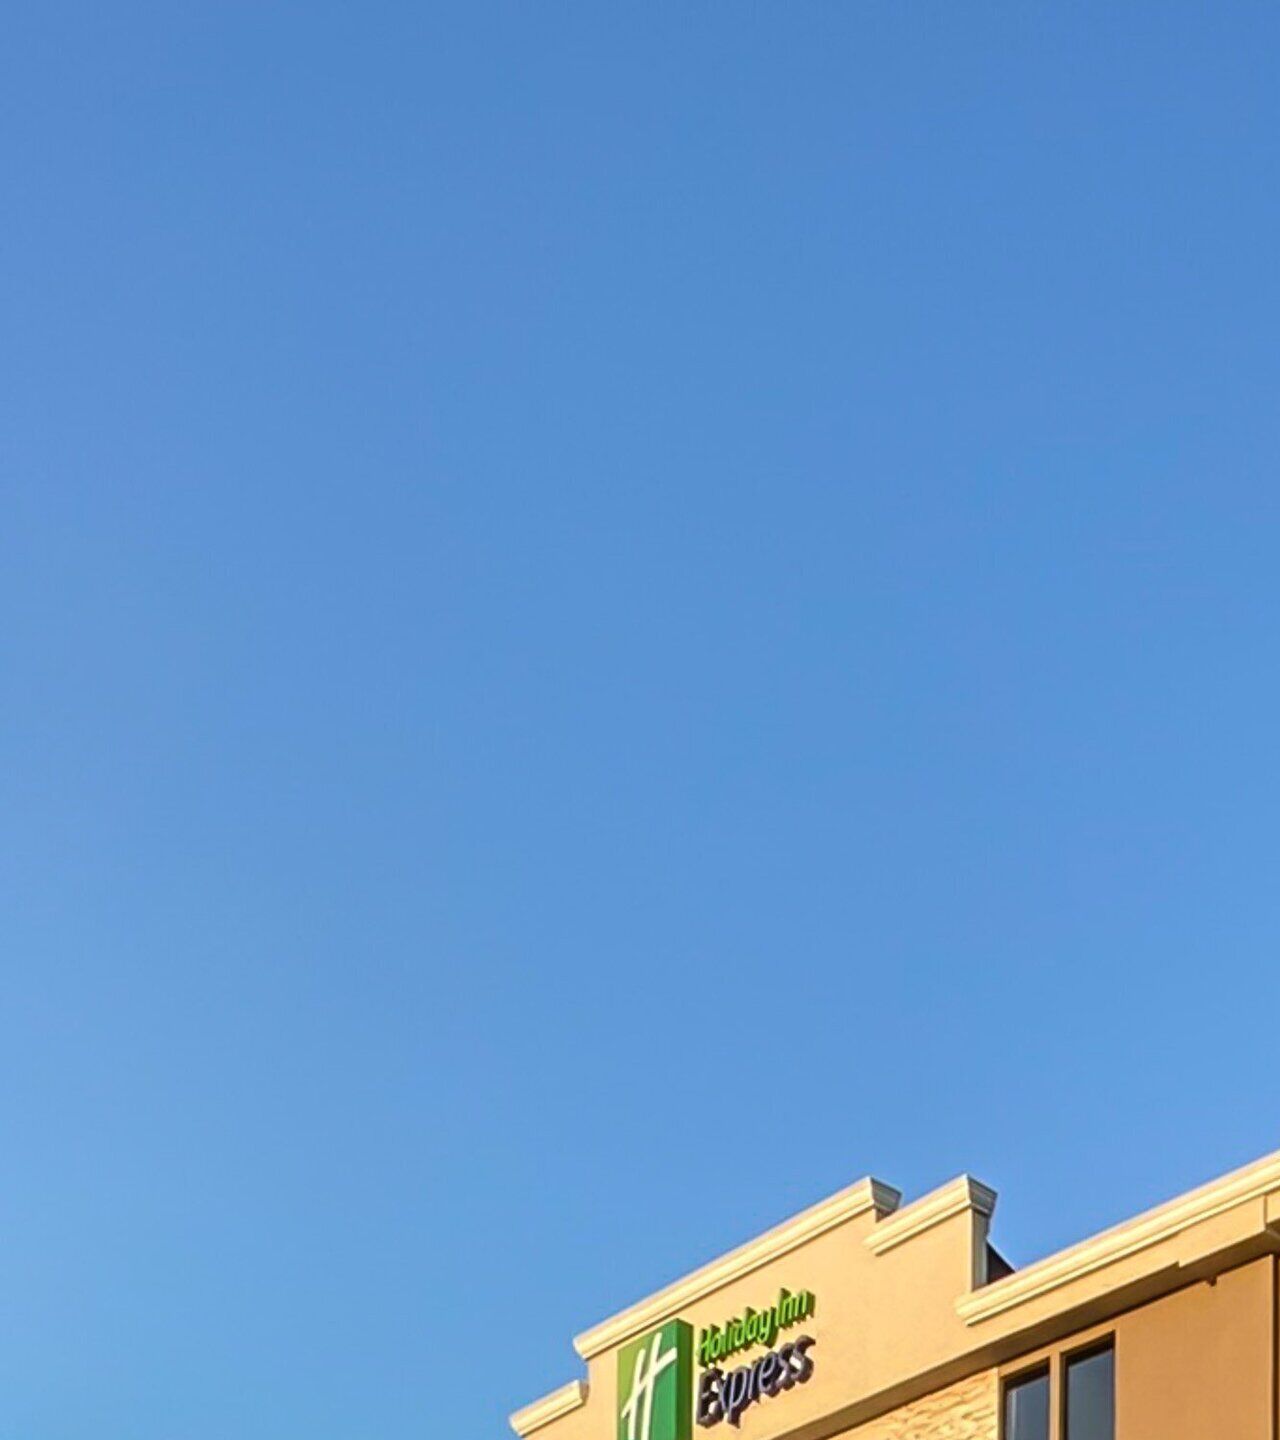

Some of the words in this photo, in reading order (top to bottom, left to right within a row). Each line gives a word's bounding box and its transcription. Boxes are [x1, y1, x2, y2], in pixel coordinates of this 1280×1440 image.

[698, 1307, 776, 1367] Holiday
[776, 1288, 815, 1328] Inn
[697, 1335, 816, 1428] Express
